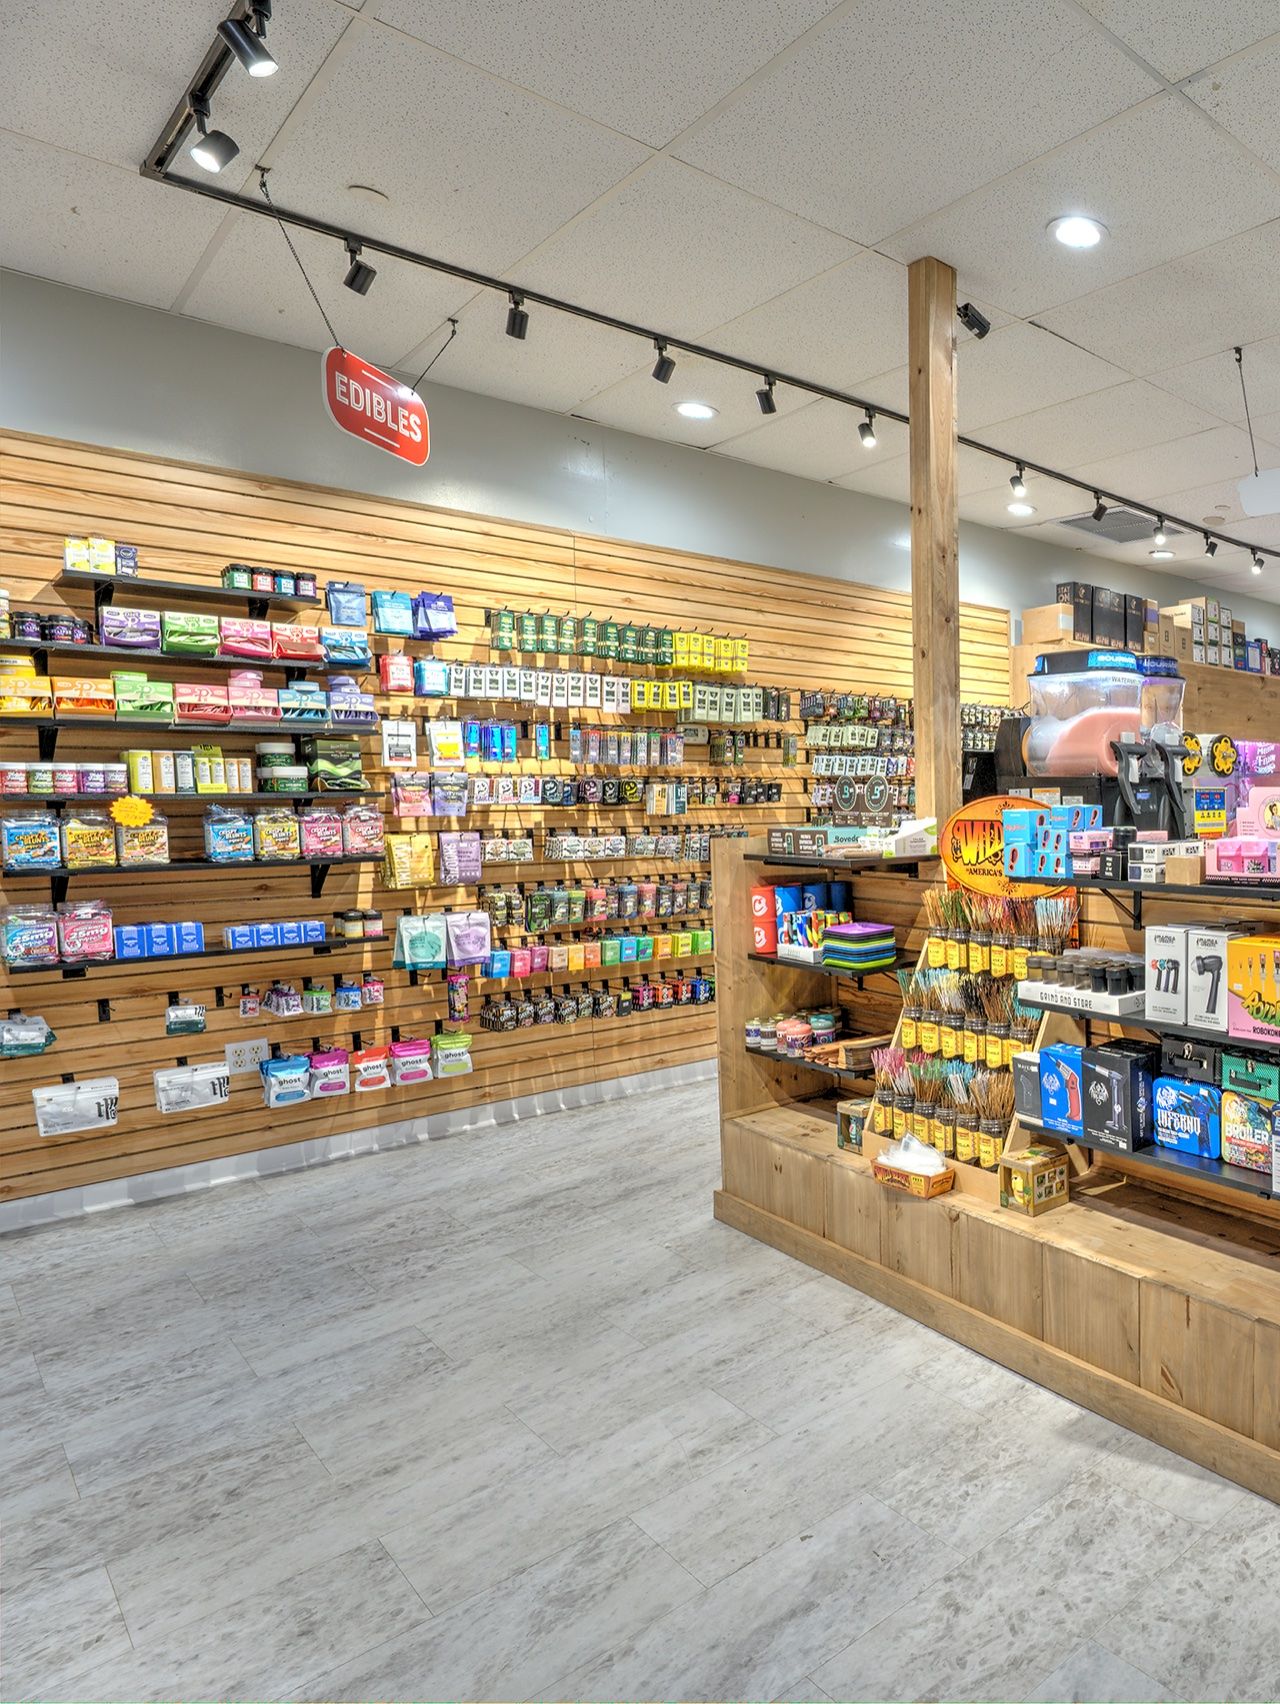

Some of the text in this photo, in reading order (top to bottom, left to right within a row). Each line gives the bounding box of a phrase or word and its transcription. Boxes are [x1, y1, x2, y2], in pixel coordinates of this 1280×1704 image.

[335, 371, 422, 443] EDIBLES
[952, 819, 1004, 866] WILD
[70, 926, 108, 938] 25mg
[1039, 992, 1093, 1009] GRIND AND STORE
[444, 1051, 464, 1060] ghost
[362, 1063, 382, 1073] ghost
[401, 1058, 422, 1067] ghost
[323, 1068, 343, 1078] ghost
[278, 1076, 302, 1087] ghost
[1157, 1108, 1201, 1136] INFERNO
[1225, 1122, 1269, 1146] BROILER
